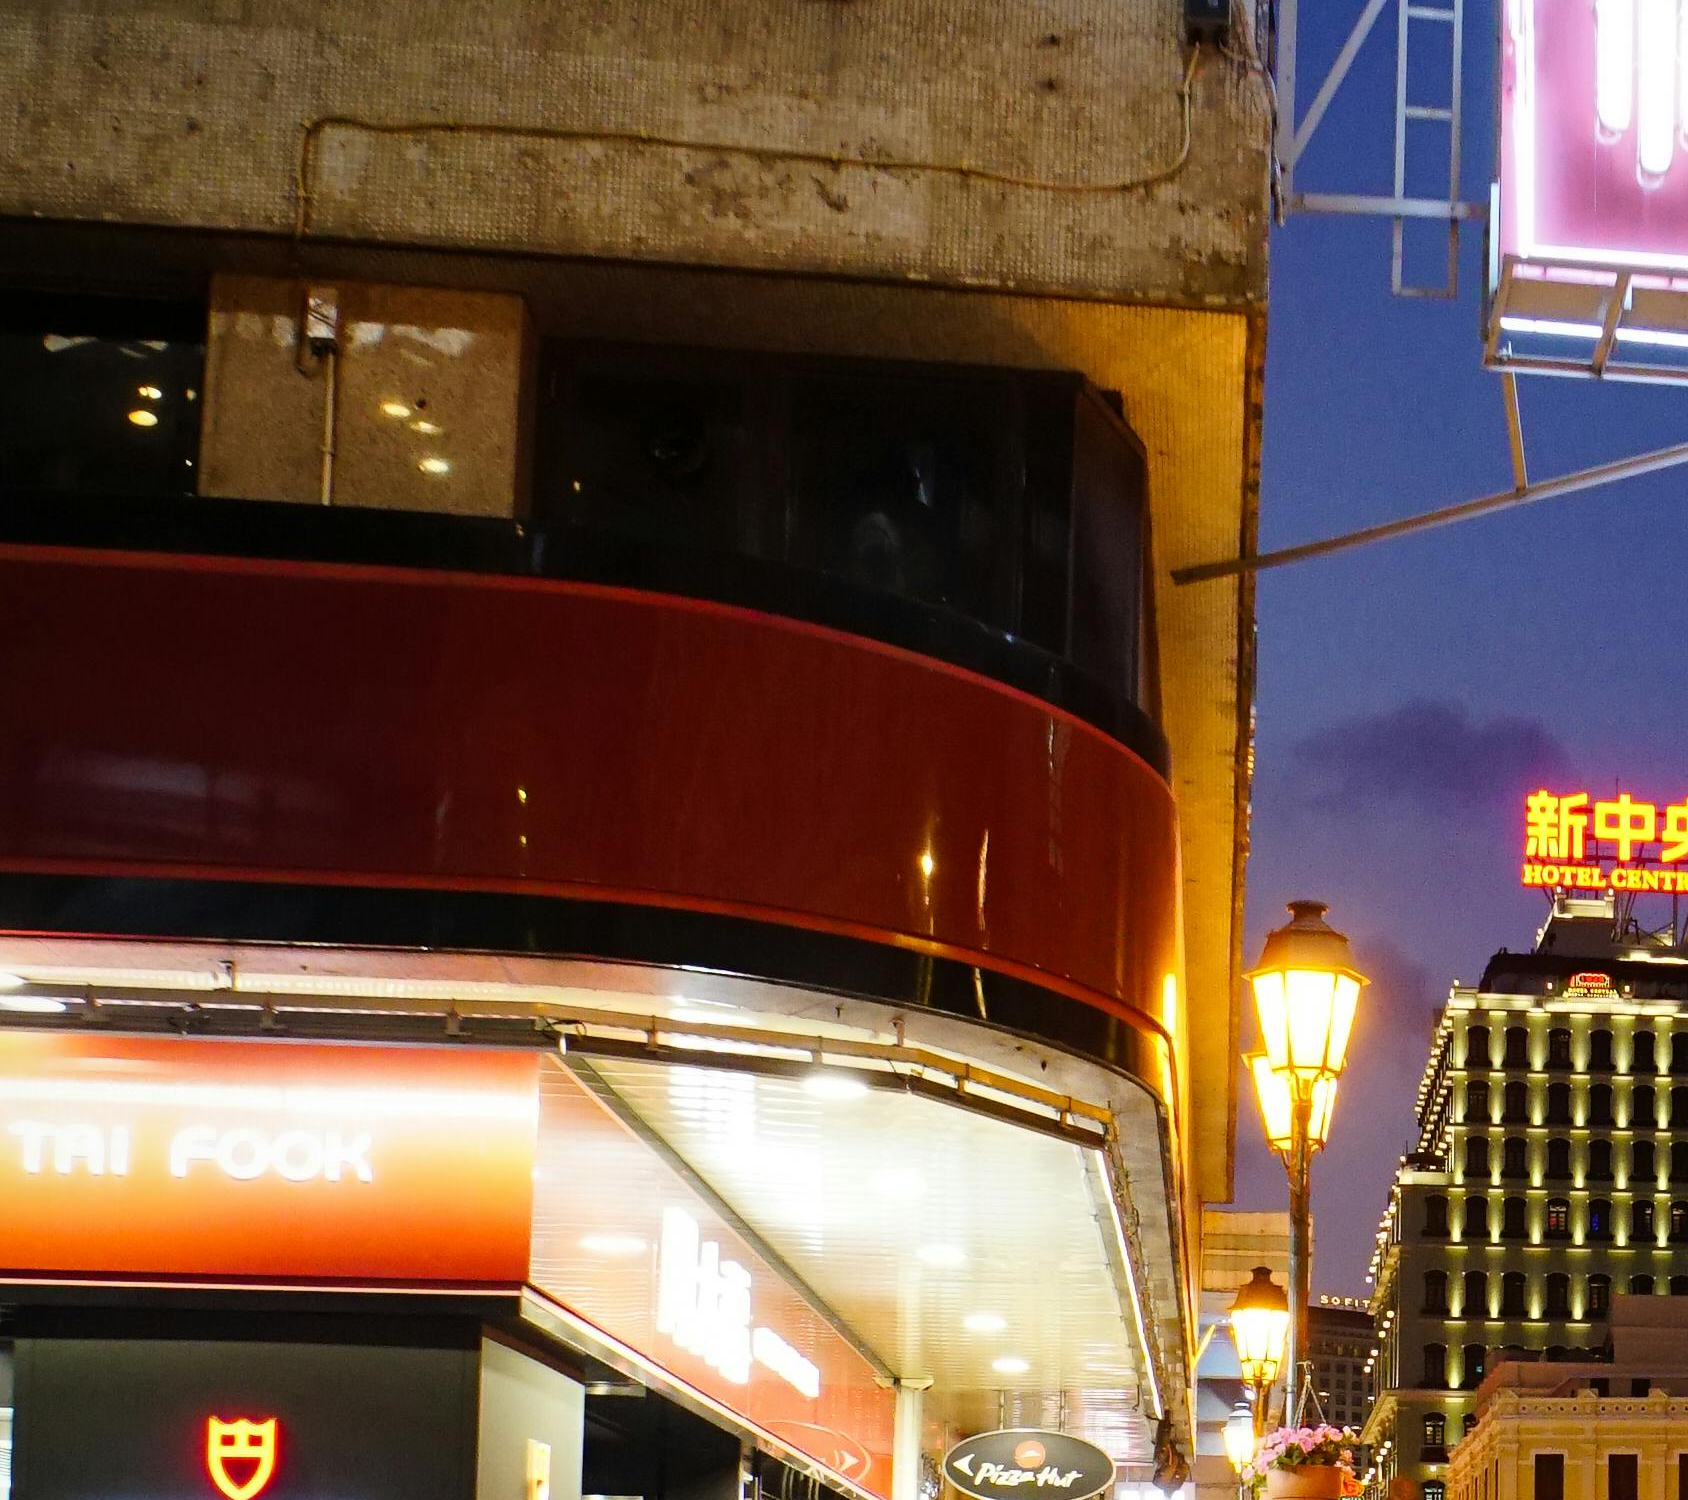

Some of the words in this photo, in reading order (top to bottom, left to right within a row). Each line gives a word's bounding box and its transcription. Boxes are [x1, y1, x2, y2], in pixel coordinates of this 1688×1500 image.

[1523, 864, 1607, 889] HOTEL
[8, 1120, 130, 1177] TAI
[170, 1124, 374, 1184] FOOK
[974, 1462, 1036, 1487] Pizza
[1035, 1465, 1083, 1488] Hut
